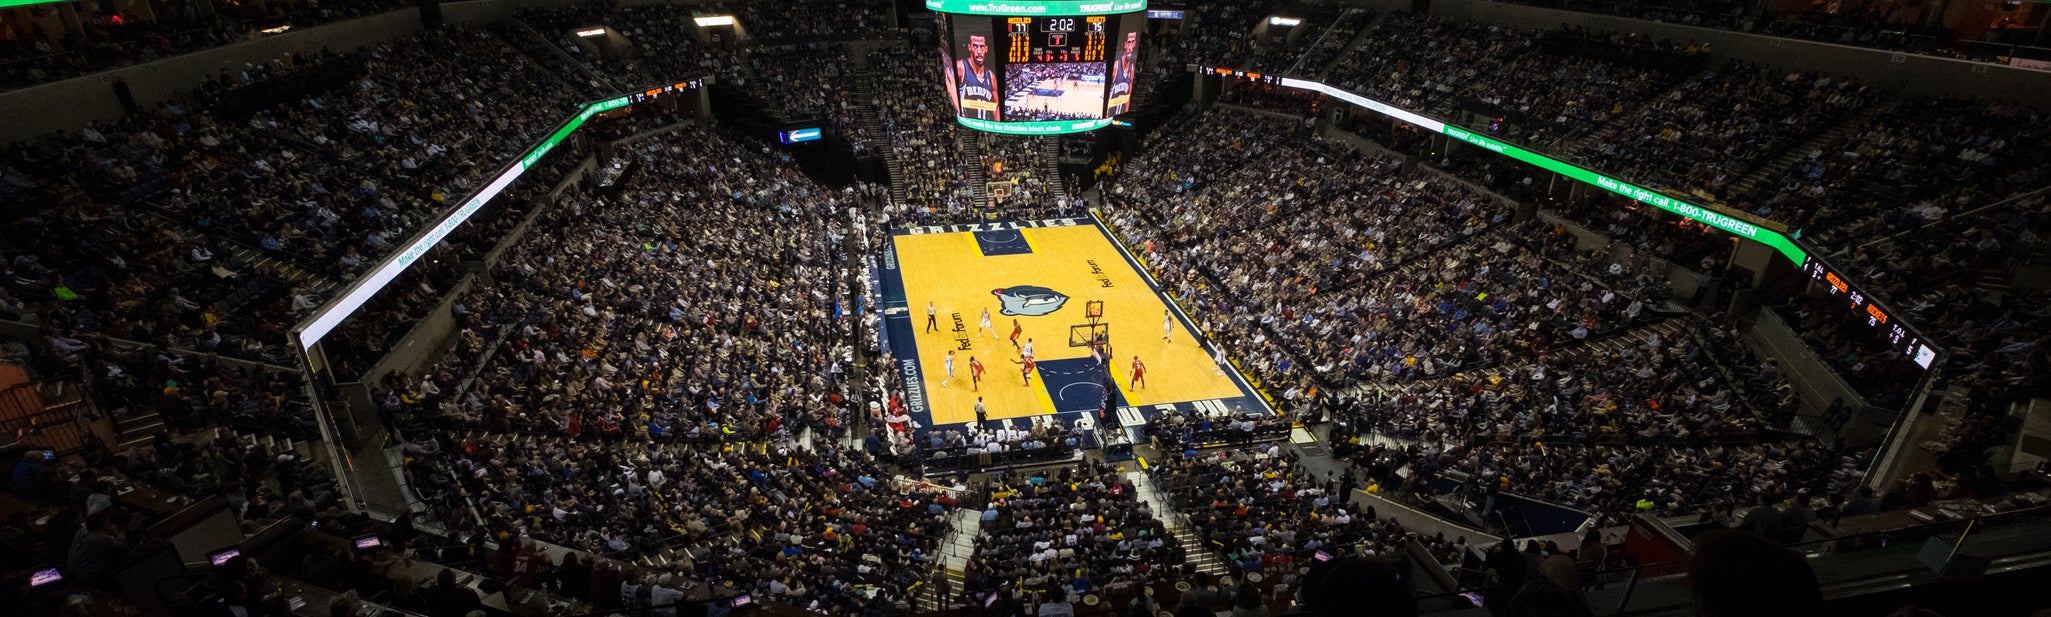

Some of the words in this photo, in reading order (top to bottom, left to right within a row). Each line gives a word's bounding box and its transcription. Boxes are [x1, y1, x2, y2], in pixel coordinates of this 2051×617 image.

[969, 4, 1046, 13] www.TruGreen.com
[1016, 23, 1026, 32] 77
[1050, 18, 1074, 31] 2:02
[1092, 22, 1103, 32] 75
[1597, 176, 1617, 190] Make
[1619, 183, 1633, 195] the
[1633, 189, 1652, 202] right
[1654, 195, 1670, 208] call.
[1673, 201, 1758, 237] 1-800-TRUGREEN
[909, 218, 1077, 235] GRIZZLIES
[398, 251, 414, 267] Make
[414, 244, 423, 255] the
[424, 233, 436, 248] right
[1086, 259, 1114, 288] FedForum
[1850, 290, 1864, 306] 2:02
[951, 312, 972, 351] FedForum
[1906, 345, 1913, 355] 5
[902, 359, 924, 413] GRIZZLIES.COM
[514, 560, 528, 573] 34
